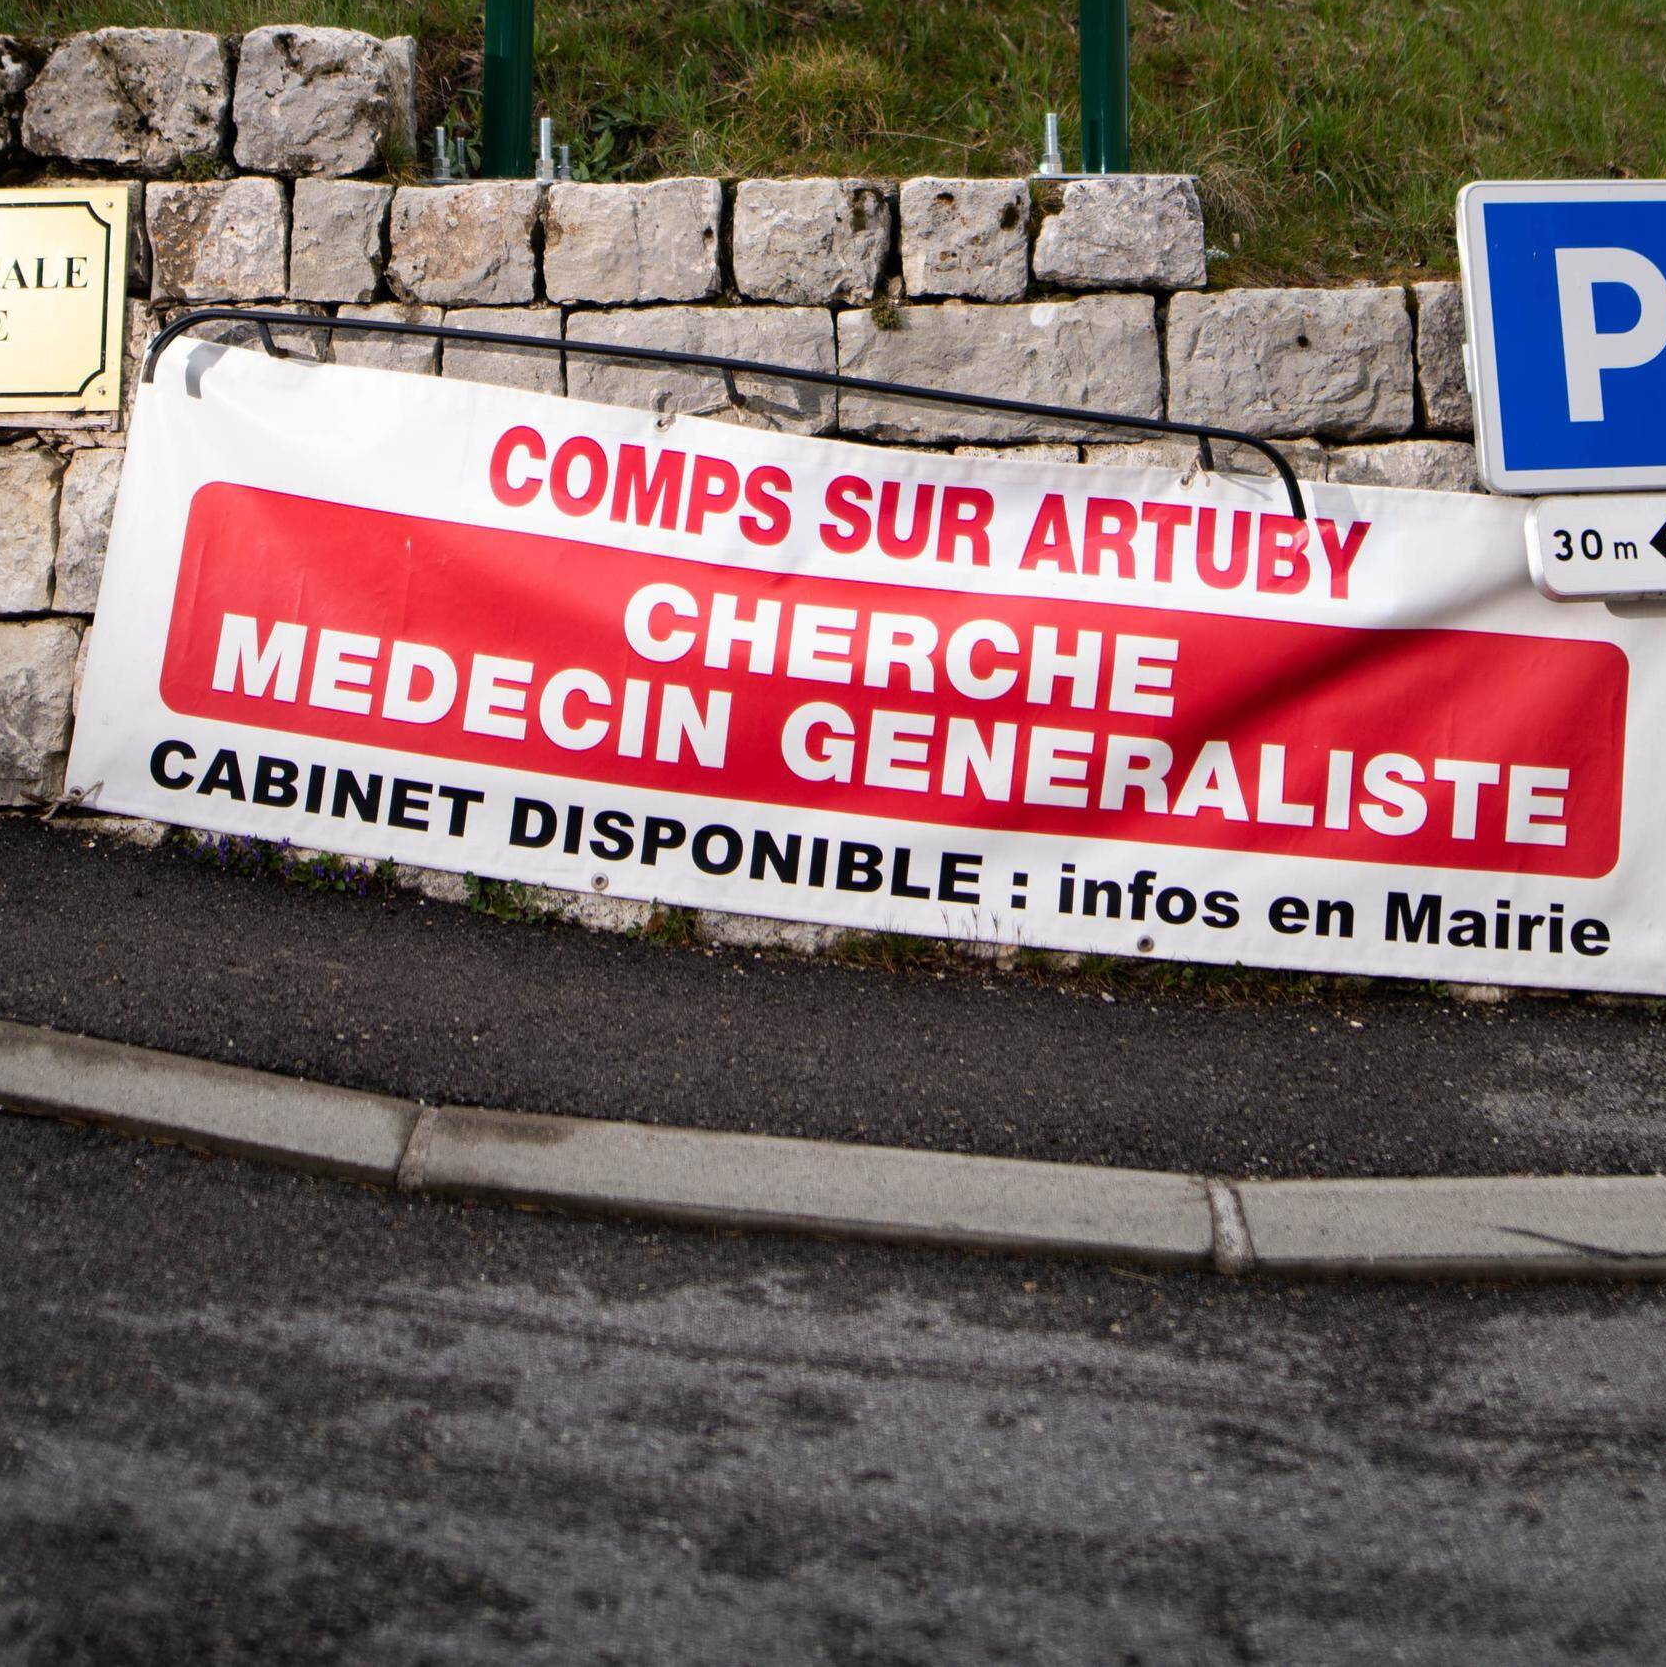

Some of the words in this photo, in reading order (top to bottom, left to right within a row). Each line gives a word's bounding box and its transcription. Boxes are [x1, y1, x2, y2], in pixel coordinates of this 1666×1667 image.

[490, 426, 792, 545] COMPS
[820, 476, 994, 563] SUR
[1018, 494, 1370, 600] ARTUBY
[1554, 529, 1602, 561] 30
[1614, 542, 1637, 559] m
[212, 613, 732, 768] MEDECIN
[782, 702, 1569, 845] GENERALISTE
[624, 583, 1178, 716] CHERCHE
[150, 740, 484, 837] CABINET
[509, 797, 983, 904] DISPONIBLE
[1059, 863, 1239, 928] infos
[1269, 897, 1354, 938] en
[1385, 892, 1610, 956] Mairie
